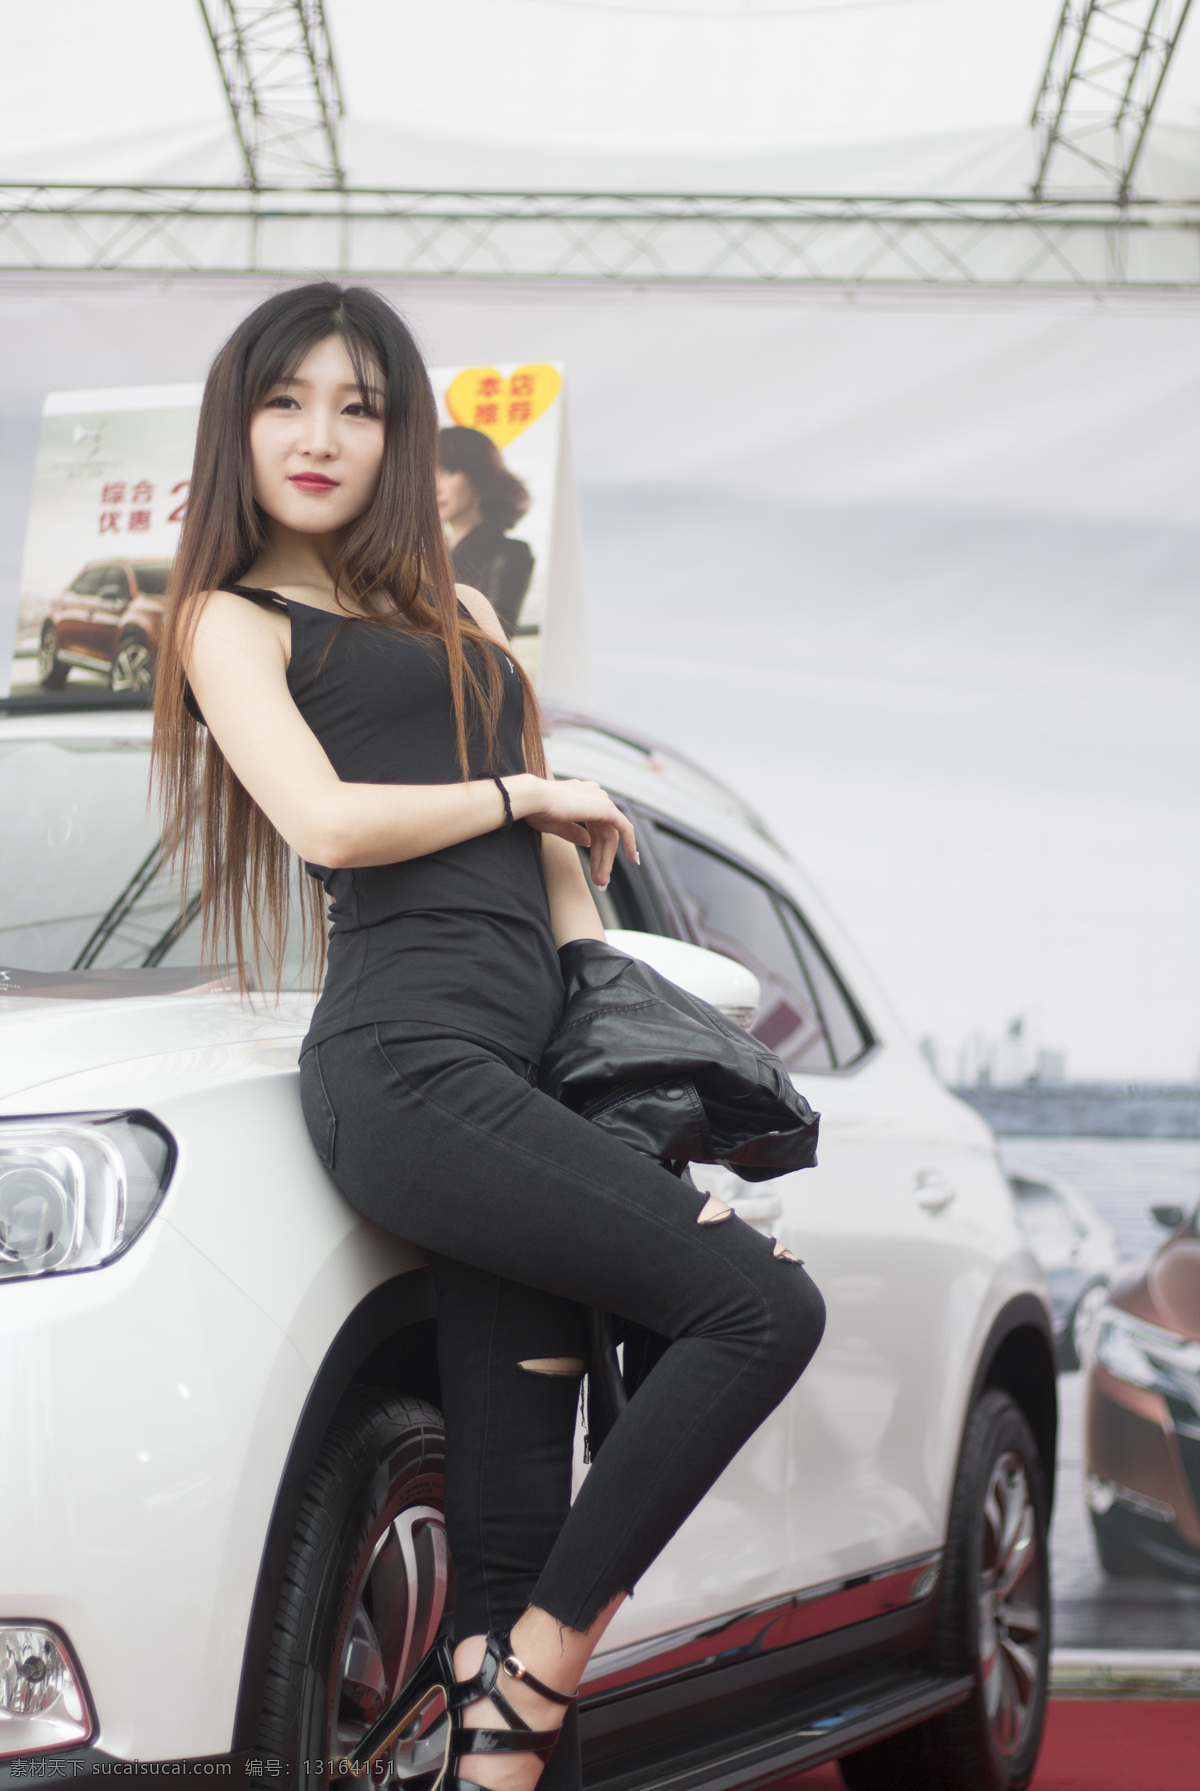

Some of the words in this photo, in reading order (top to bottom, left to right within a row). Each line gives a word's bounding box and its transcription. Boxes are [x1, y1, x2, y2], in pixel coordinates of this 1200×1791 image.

[478, 374, 535, 397] 本店
[475, 401, 532, 424] 推荐
[102, 480, 154, 504] 综合
[99, 510, 151, 534] 优惠
